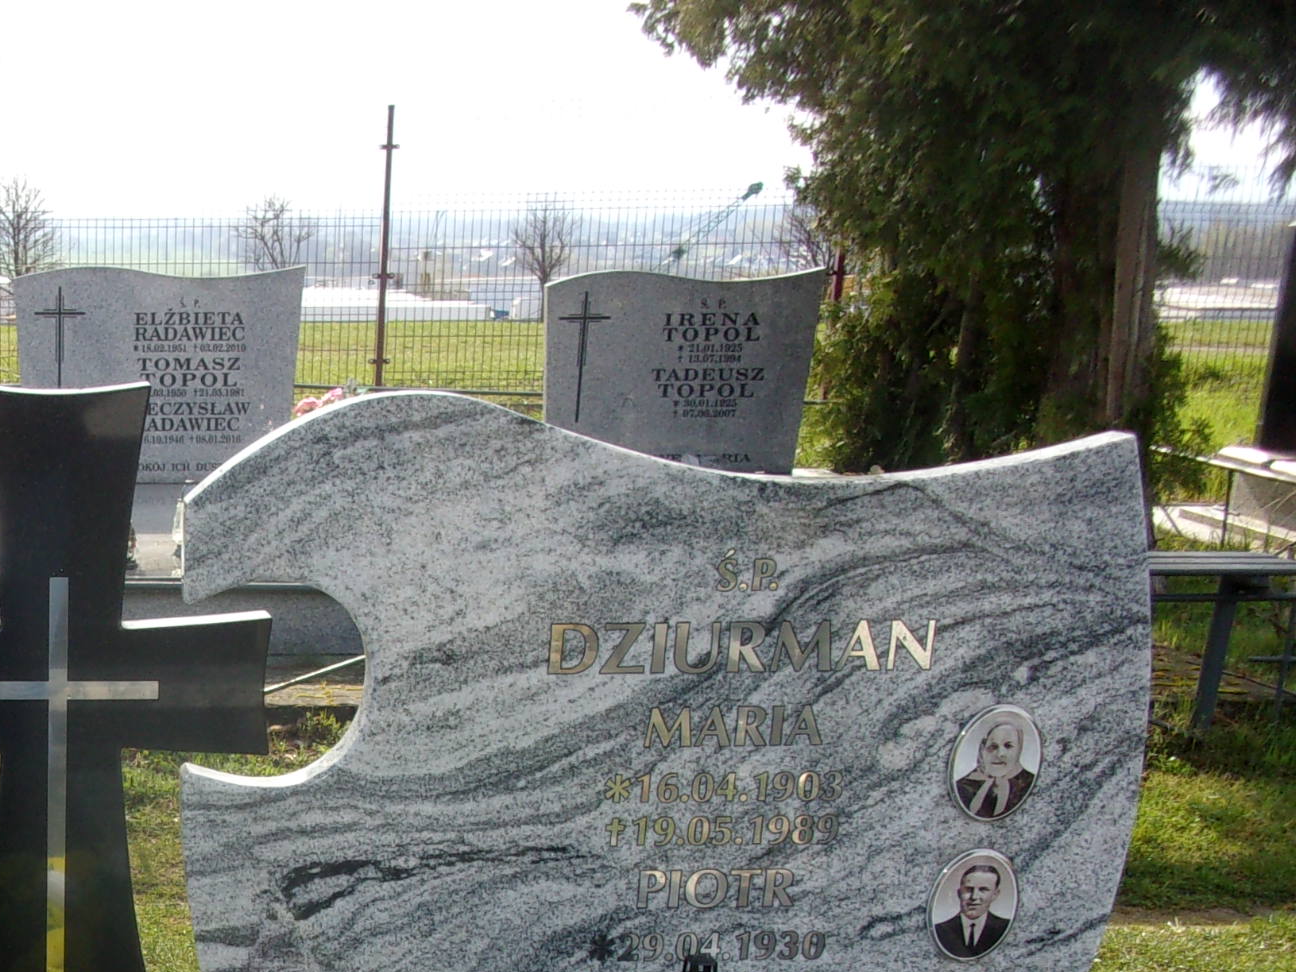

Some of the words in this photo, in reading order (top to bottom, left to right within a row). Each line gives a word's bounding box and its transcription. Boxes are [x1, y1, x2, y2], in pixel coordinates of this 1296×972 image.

[133, 307, 245, 326] ELŻBIETA
[664, 312, 760, 327] IRENA
[133, 326, 246, 342] RADAWIEC
[662, 327, 760, 342] TOPOL
[137, 357, 241, 372] TOMASZ
[651, 367, 765, 382] TADEUSZ
[657, 383, 754, 398] TOPOL
[147, 401, 251, 416] ECZYSŁAW
[144, 417, 240, 432] ADAWIEC
[716, 548, 779, 592] Ś.P.
[546, 619, 937, 675] DZIURMAN
[643, 704, 823, 748] MARIA
[636, 867, 796, 909] PIOTR
